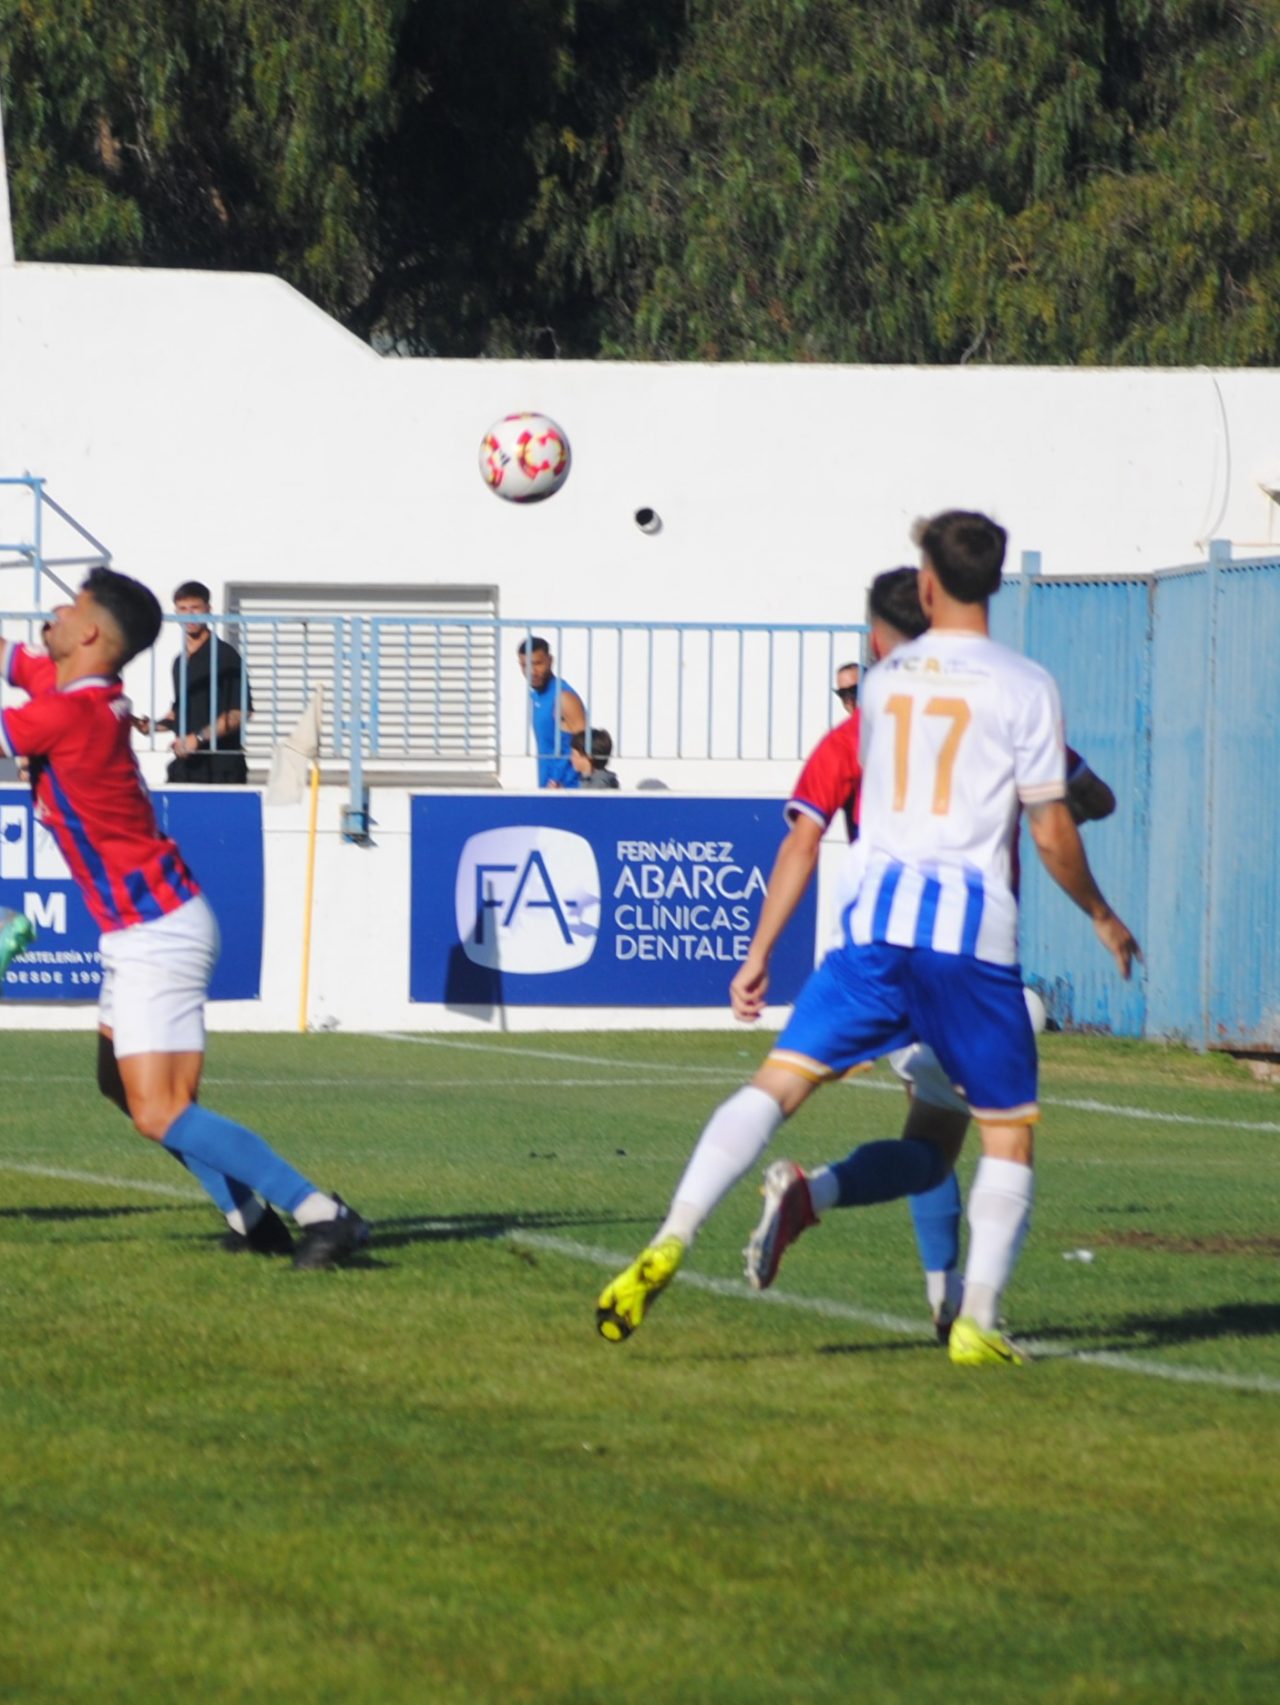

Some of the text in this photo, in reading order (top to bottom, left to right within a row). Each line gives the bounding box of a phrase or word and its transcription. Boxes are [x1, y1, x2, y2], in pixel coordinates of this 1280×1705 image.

[884, 694, 972, 816] 17
[616, 838, 734, 863] FERNÁNDEZ
[613, 865, 768, 900] ABARCA
[614, 901, 750, 931] CLÍNICAS
[615, 935, 751, 961] DENTALE
[6, 970, 107, 984] DESDE 199
